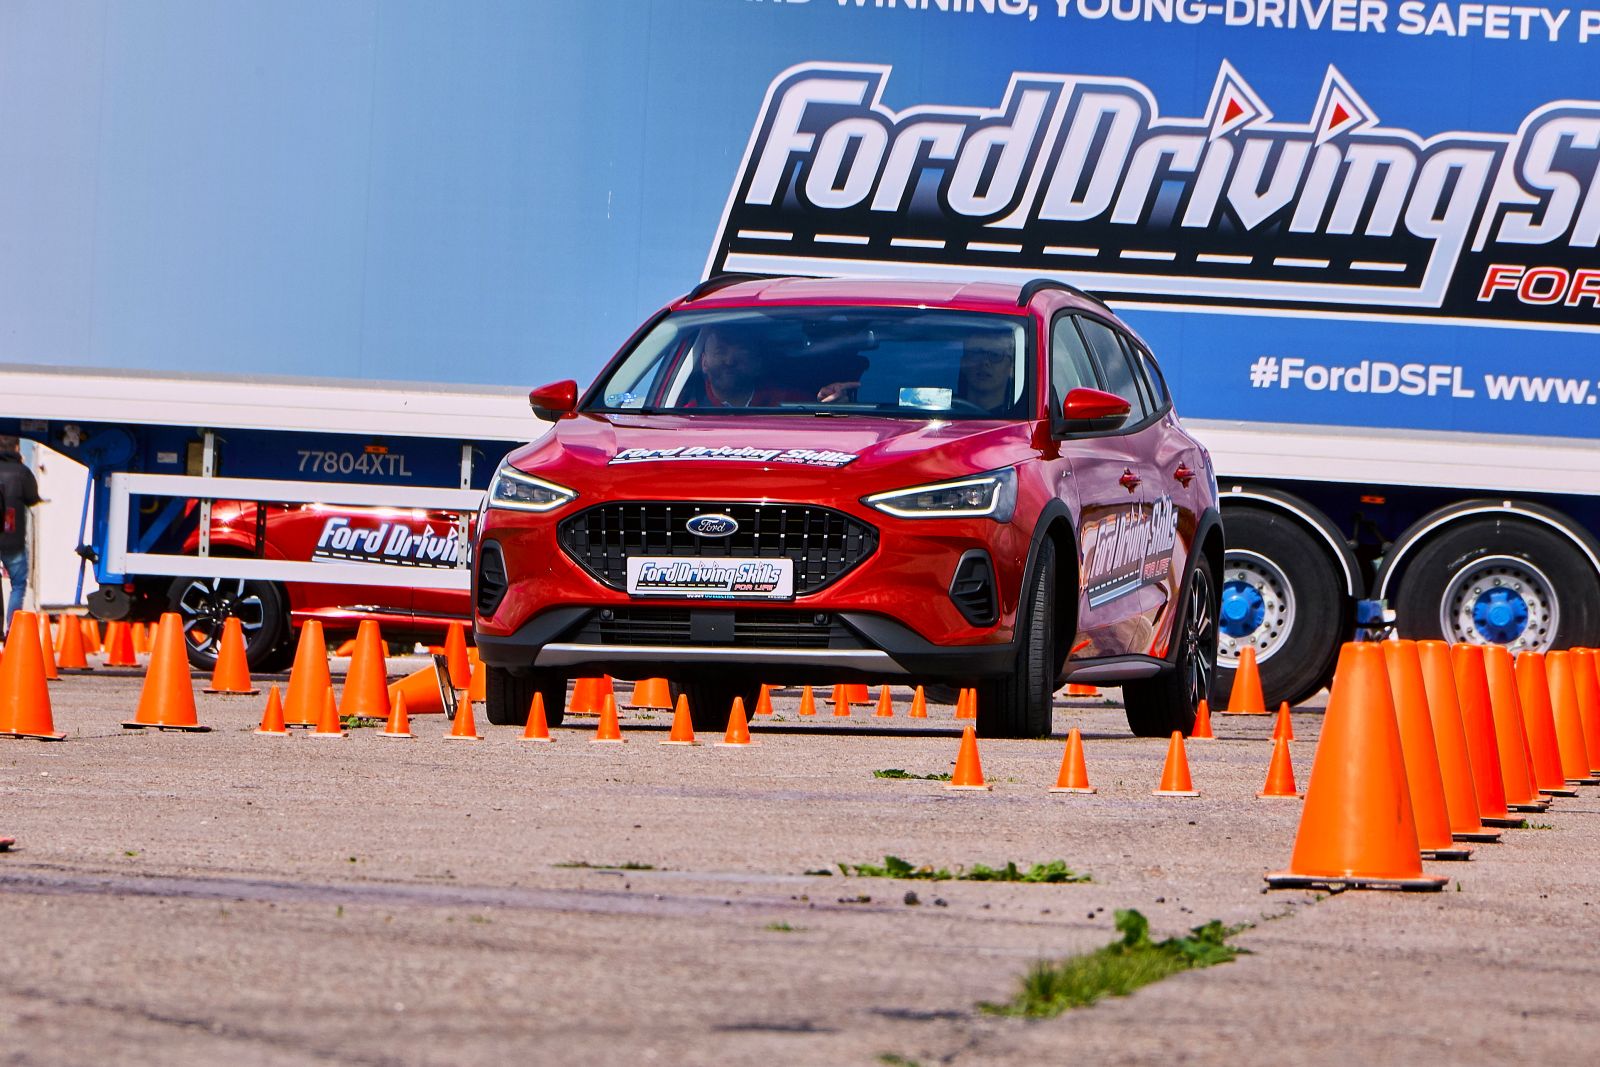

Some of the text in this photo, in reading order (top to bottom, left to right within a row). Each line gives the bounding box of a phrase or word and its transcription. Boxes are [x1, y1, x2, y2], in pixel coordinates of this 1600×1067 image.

[1396, 1, 1571, 42] SAFETY
[1250, 356, 1475, 398] #FordDSFL
[297, 450, 412, 476] 77804XTL
